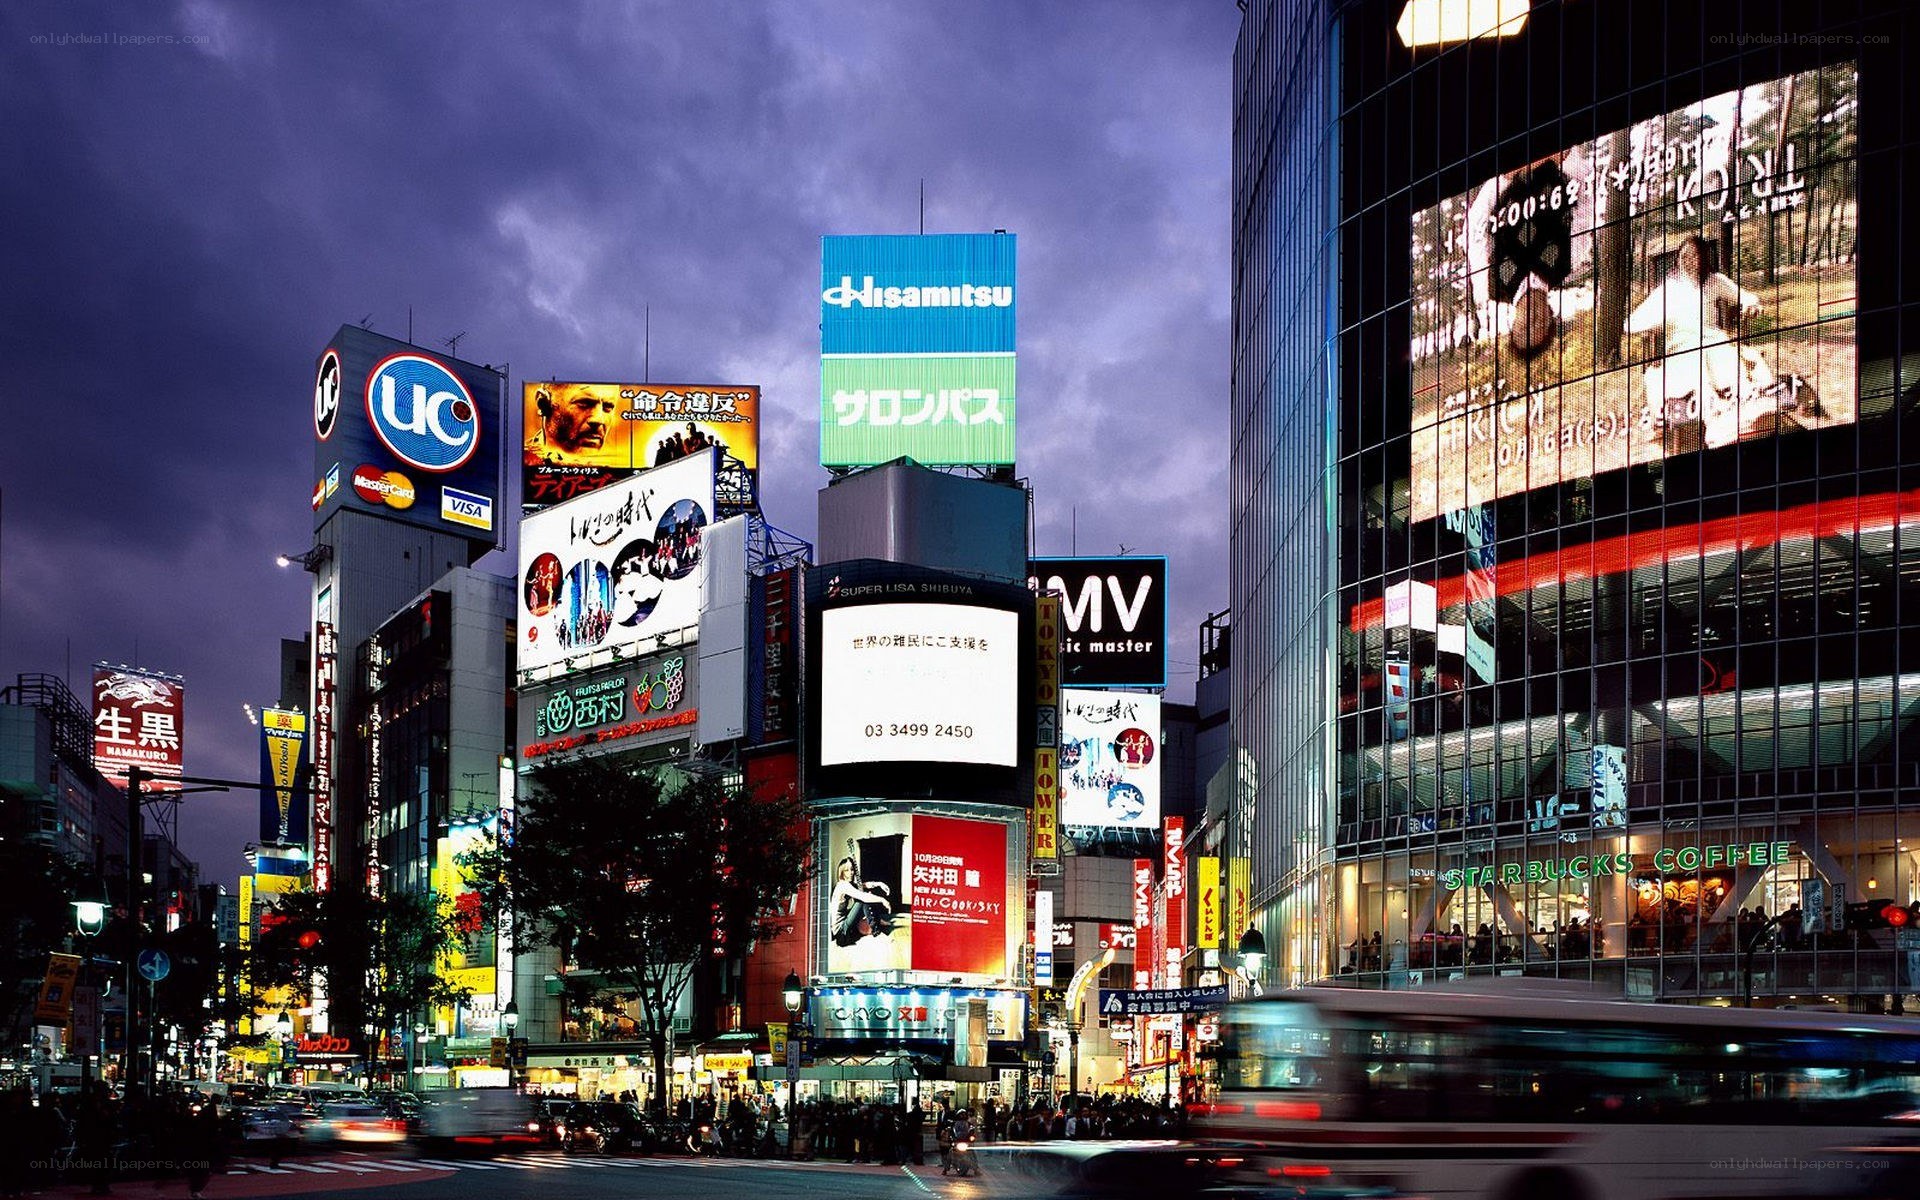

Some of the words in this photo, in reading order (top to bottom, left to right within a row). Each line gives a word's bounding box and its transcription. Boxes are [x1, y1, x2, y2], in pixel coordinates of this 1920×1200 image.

[1677, 143, 1805, 220] TRICK
[822, 275, 1012, 308] Hisamitsu
[832, 387, 1004, 426] サロンパス
[1443, 384, 1545, 452] TRICK
[354, 474, 416, 500] MasterCard
[538, 467, 599, 475] ブルース・ウィリス
[451, 499, 482, 517] VISA
[840, 584, 882, 597] SUPER
[886, 583, 916, 593] LISA
[921, 583, 973, 595] SHIBUYA
[1028, 575, 1153, 633] MV
[1038, 604, 1055, 700] TOKYO
[1090, 640, 1153, 653] master
[575, 691, 625, 729] 西村
[1037, 708, 1054, 744] 文庫
[95, 706, 179, 751] 生黒
[865, 724, 883, 738] 03
[890, 723, 929, 738] 3499
[935, 724, 973, 738] 2450
[106, 746, 169, 761] NAMAKURO
[1036, 753, 1055, 848] TOWER
[913, 865, 958, 886] 矢井田
[1167, 827, 1183, 898] さくらや
[1445, 852, 1634, 890] STARBUCKS
[1654, 841, 1790, 871] COFFEE
[914, 886, 930, 895] NEW
[1135, 868, 1150, 929] さくらや
[1053, 931, 1073, 946] フル
[825, 1006, 892, 1021] TOKYO
